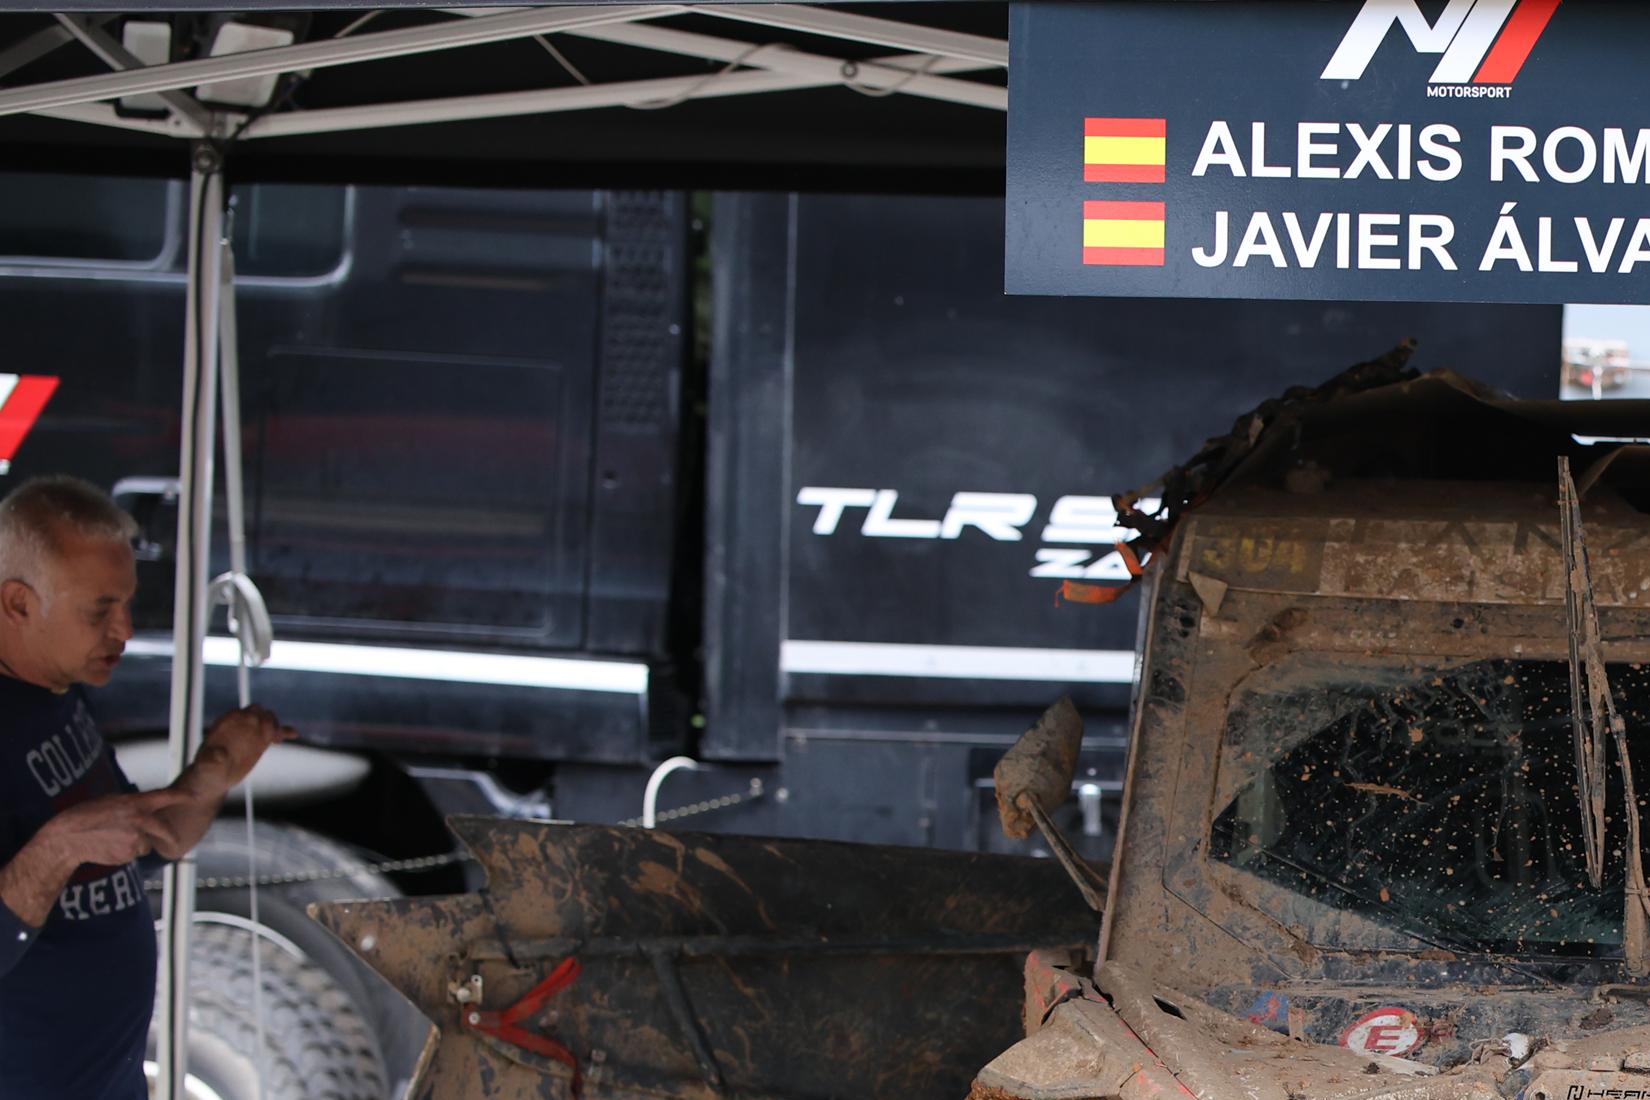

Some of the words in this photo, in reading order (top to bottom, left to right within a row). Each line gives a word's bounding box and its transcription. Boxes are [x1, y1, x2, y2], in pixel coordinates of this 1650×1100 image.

[1426, 85, 1513, 99] MOTORSPORT
[1191, 120, 1463, 182] ALEXIS
[1191, 211, 1458, 271] JAVIER
[797, 486, 1038, 542] TLR
[1028, 547, 1153, 581] ZA
